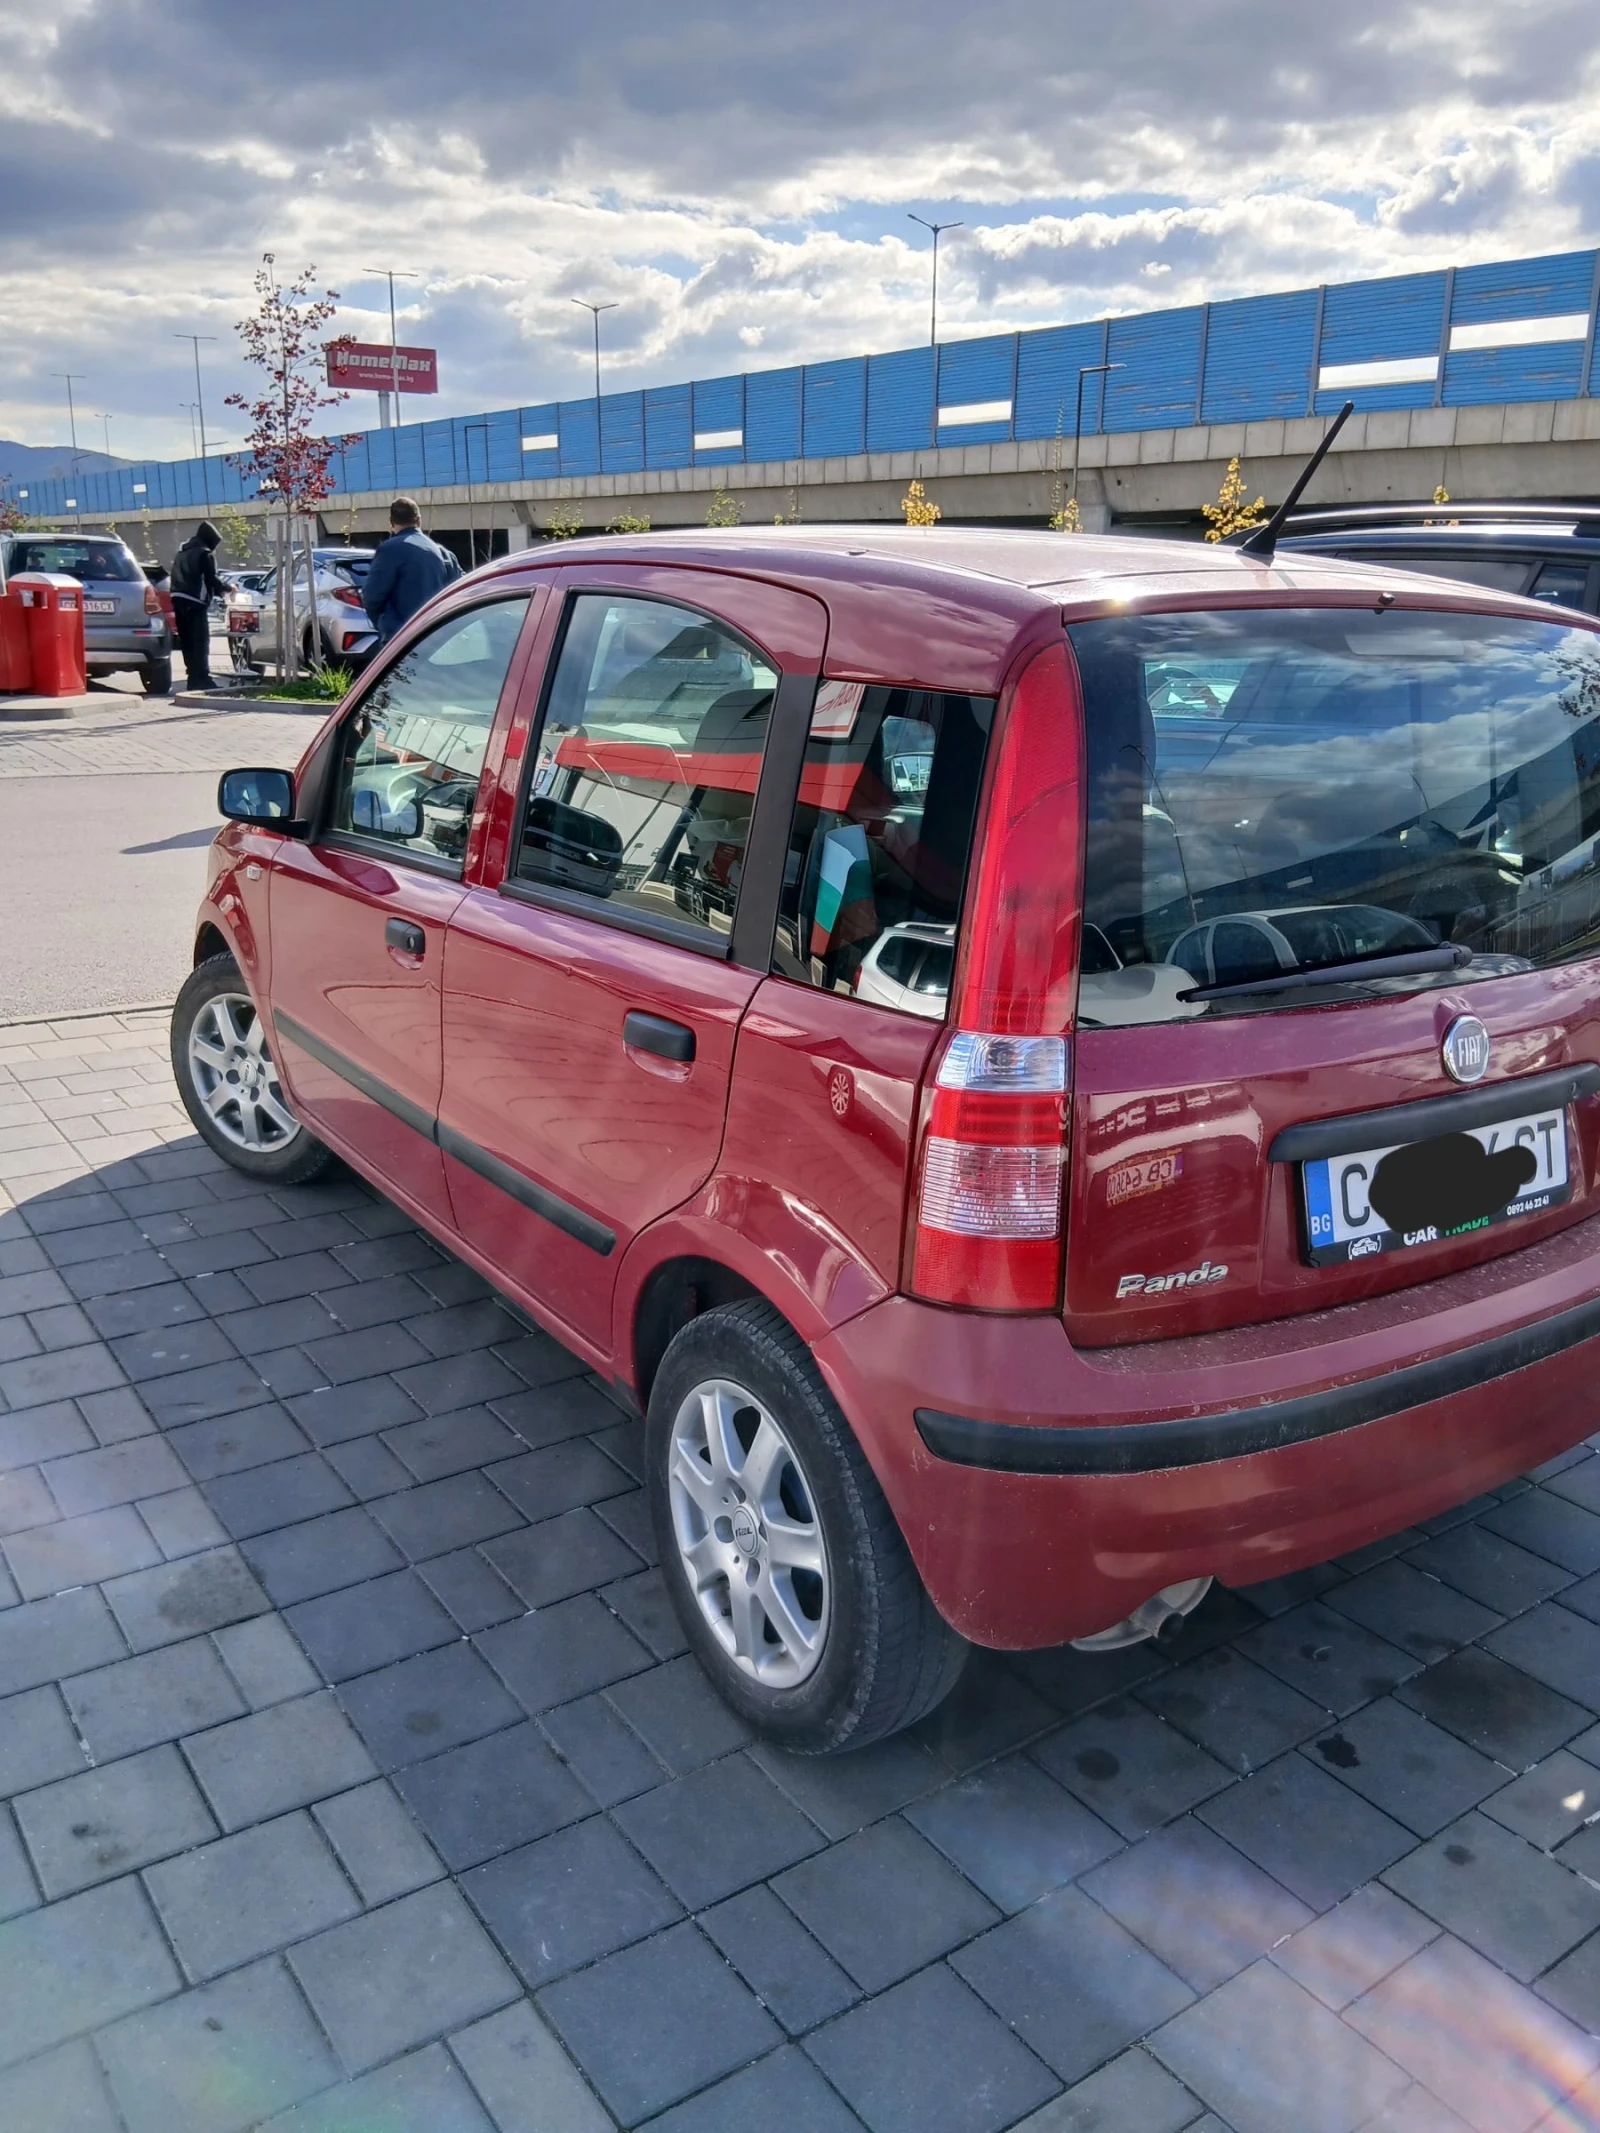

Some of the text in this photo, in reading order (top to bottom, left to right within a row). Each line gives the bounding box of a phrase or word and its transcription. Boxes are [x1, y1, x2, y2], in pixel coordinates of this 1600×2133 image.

[358, 372, 414, 383] www.home-ax.bg
[1457, 1034, 1482, 1067] FIAT
[1310, 1214, 1332, 1236] BG
[1403, 1225, 1438, 1247] CAR
[1115, 1261, 1229, 1299] Panda
